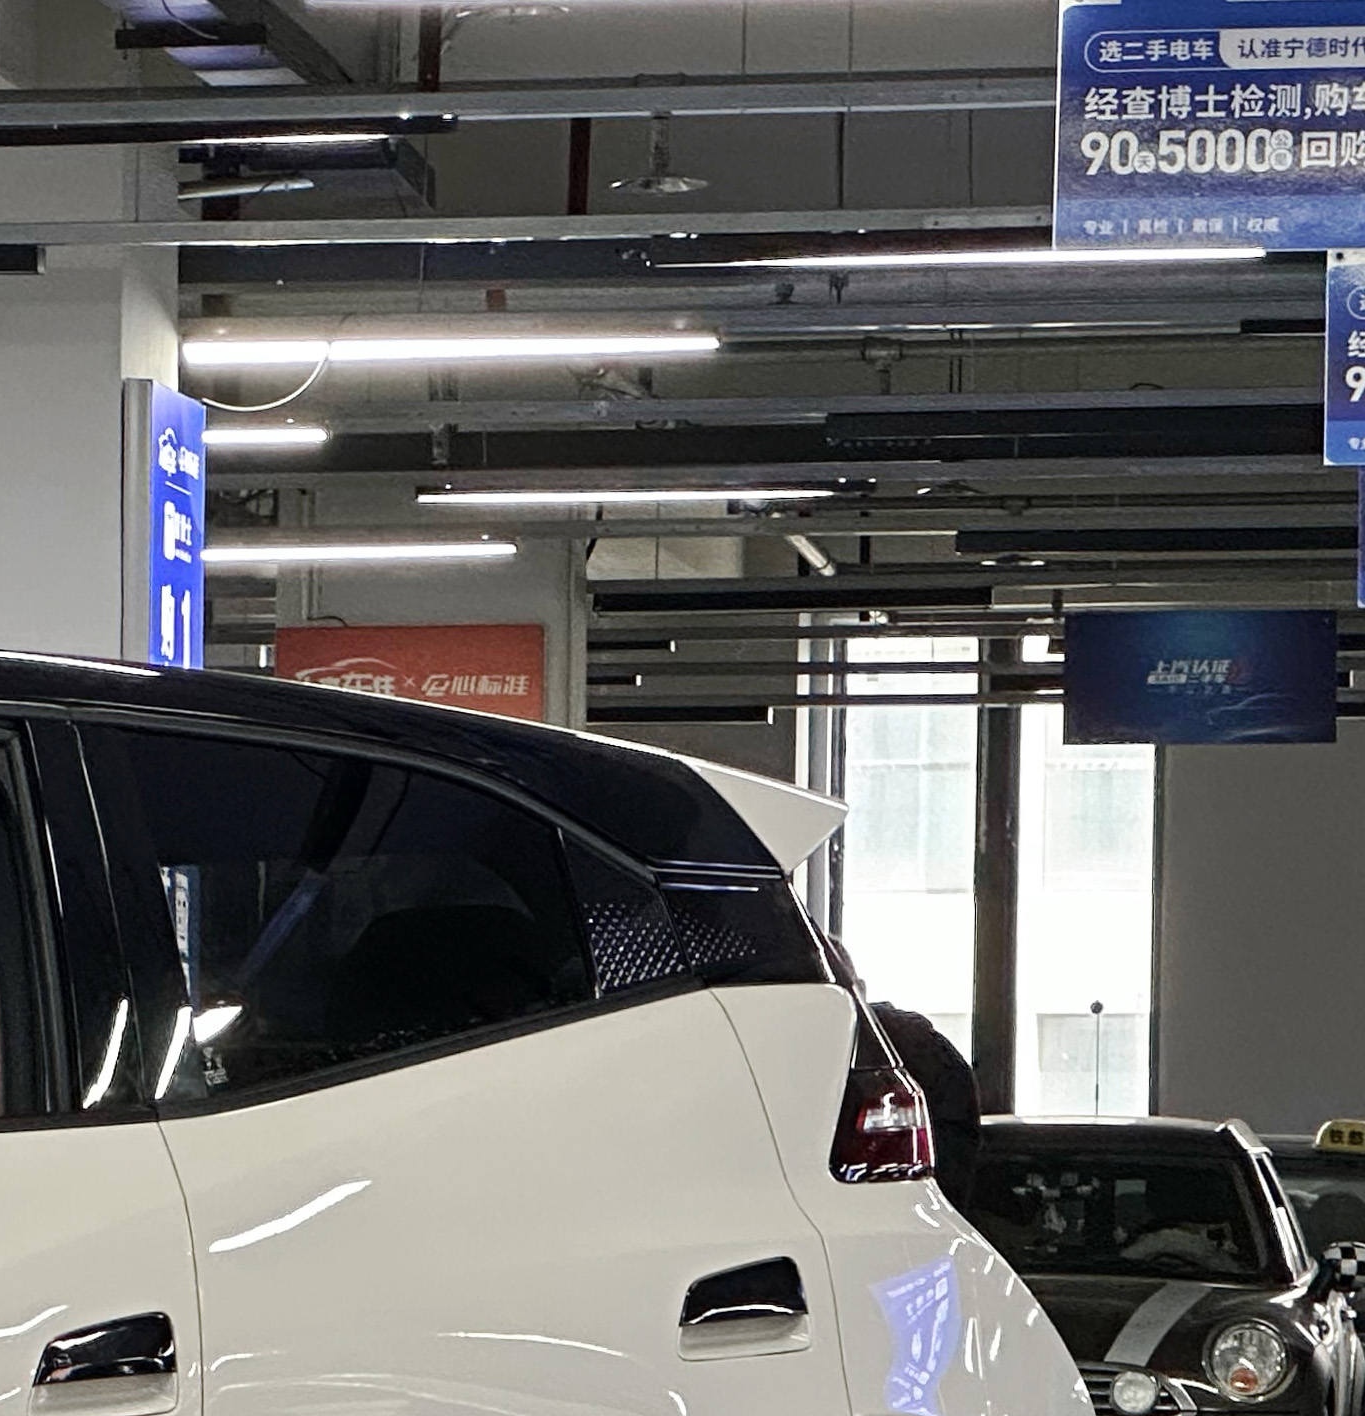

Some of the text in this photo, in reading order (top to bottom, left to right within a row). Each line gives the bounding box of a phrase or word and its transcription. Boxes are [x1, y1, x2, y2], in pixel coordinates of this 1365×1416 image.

[1099, 39, 1214, 62] 选二手电车
